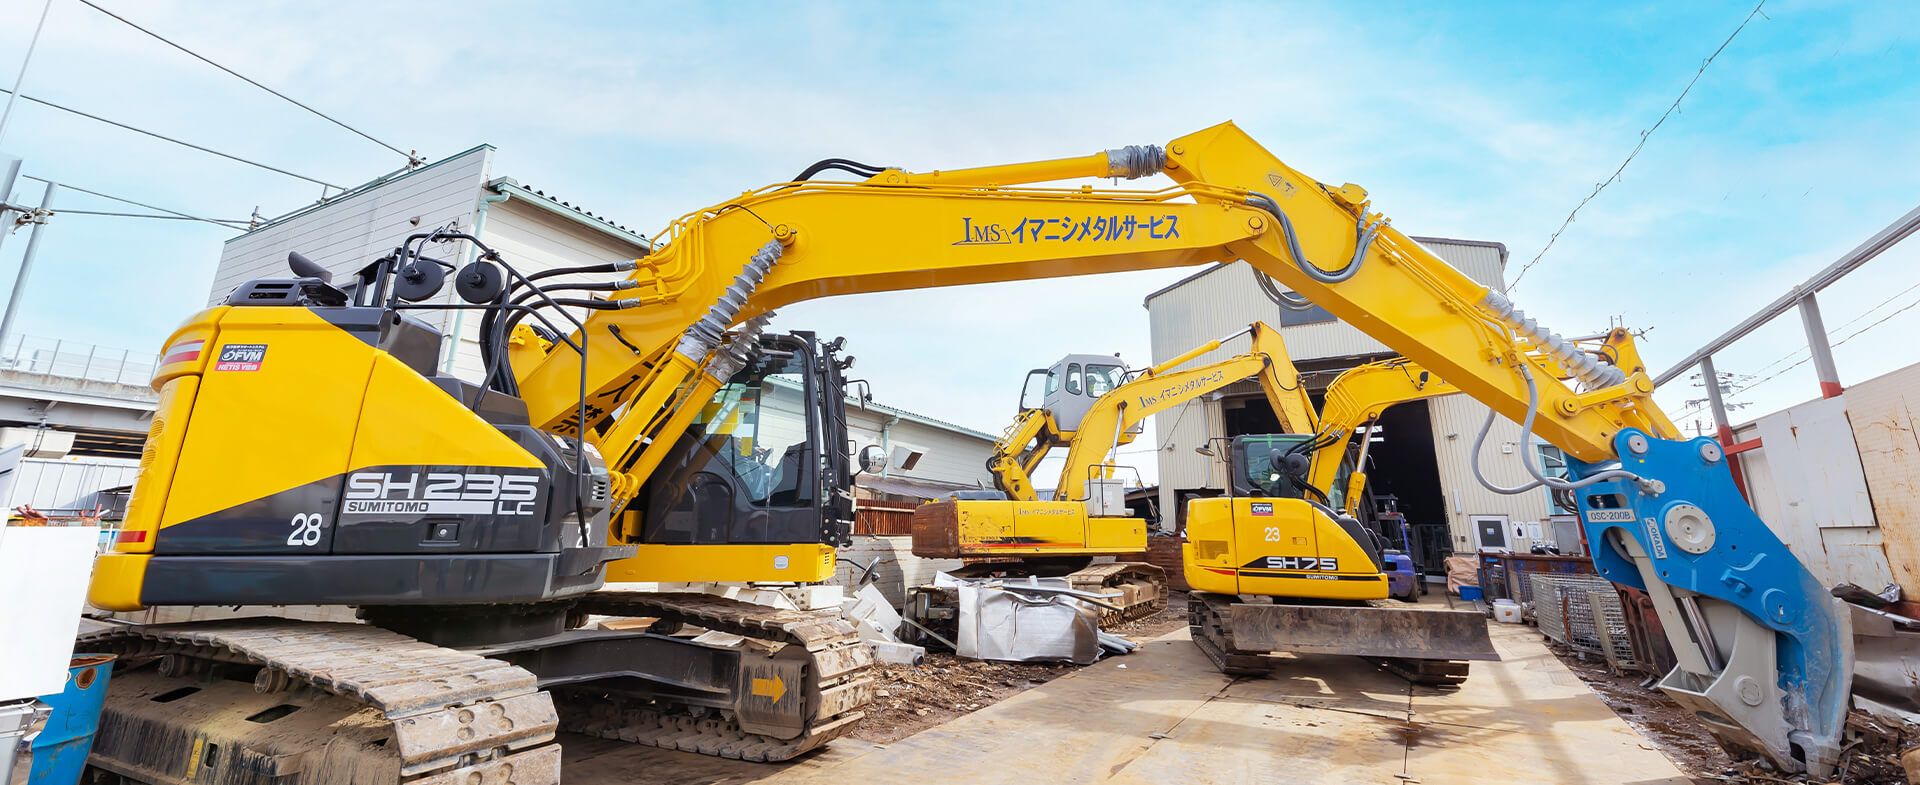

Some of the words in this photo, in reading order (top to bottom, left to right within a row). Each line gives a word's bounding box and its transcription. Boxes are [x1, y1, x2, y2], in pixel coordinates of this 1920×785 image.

[1011, 214, 1180, 244] イマニシメタルサービス
[1160, 370, 1224, 400] イマニシメタルサービス
[348, 502, 429, 513] SUMITOMO
[497, 501, 536, 515] LC
[1590, 511, 1631, 521] OSC-200B
[287, 513, 322, 546] 28
[1264, 527, 1280, 542] 23
[1650, 527, 1665, 557] OKADA
